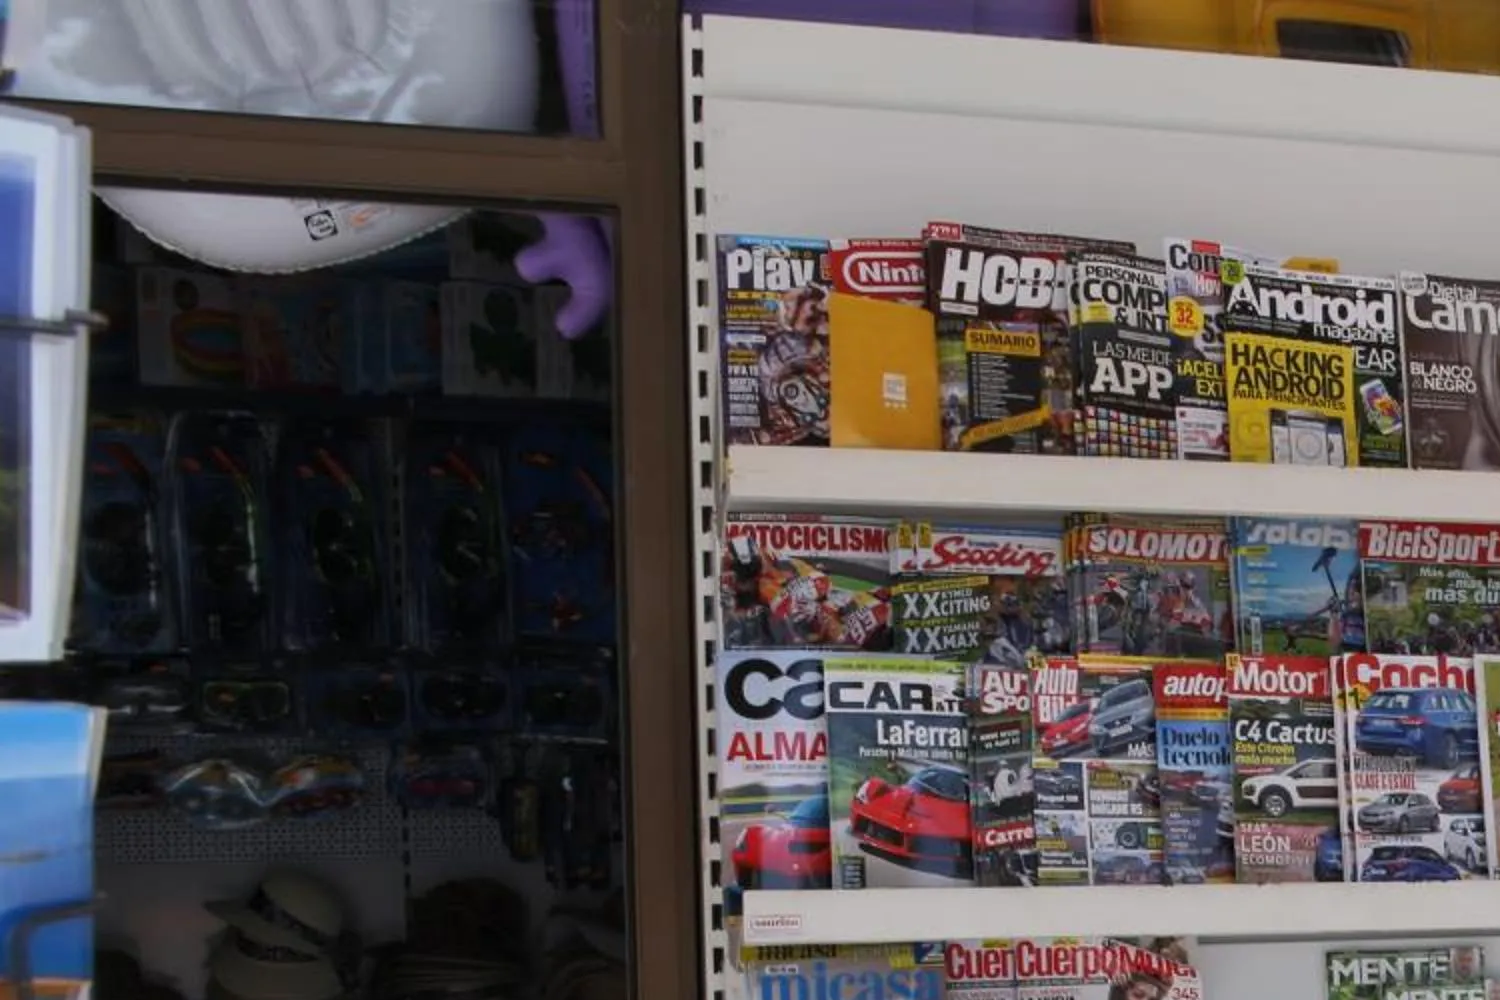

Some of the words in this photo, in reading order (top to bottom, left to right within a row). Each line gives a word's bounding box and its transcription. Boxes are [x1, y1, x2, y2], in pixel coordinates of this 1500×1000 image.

[727, 249, 814, 290] Play
[1086, 266, 1158, 288] PERSONAL
[1428, 282, 1477, 301] Digital
[1175, 306, 1194, 325] 32
[1226, 278, 1396, 334] Android
[971, 331, 1036, 348] SUMARIO
[1313, 321, 1396, 346] magazine
[1093, 340, 1124, 359] LAS
[1231, 343, 1344, 378] HACKING
[1089, 357, 1173, 399] APP
[1410, 361, 1473, 379] BLANCO
[1234, 370, 1345, 399] ANDROID
[1423, 377, 1477, 394] NEGRO
[1367, 524, 1500, 563] BiciSport
[923, 536, 1057, 582] Scooting
[1425, 588, 1468, 602] más
[1233, 659, 1316, 695] Motor
[829, 681, 934, 711] CAR
[1161, 727, 1220, 747] Duelo
[1235, 720, 1262, 743] C4
[1266, 721, 1336, 745] Cactus
[1241, 832, 1291, 853] LEÓN
[1330, 955, 1451, 986] MENTE
[1171, 987, 1199, 1000] 345
